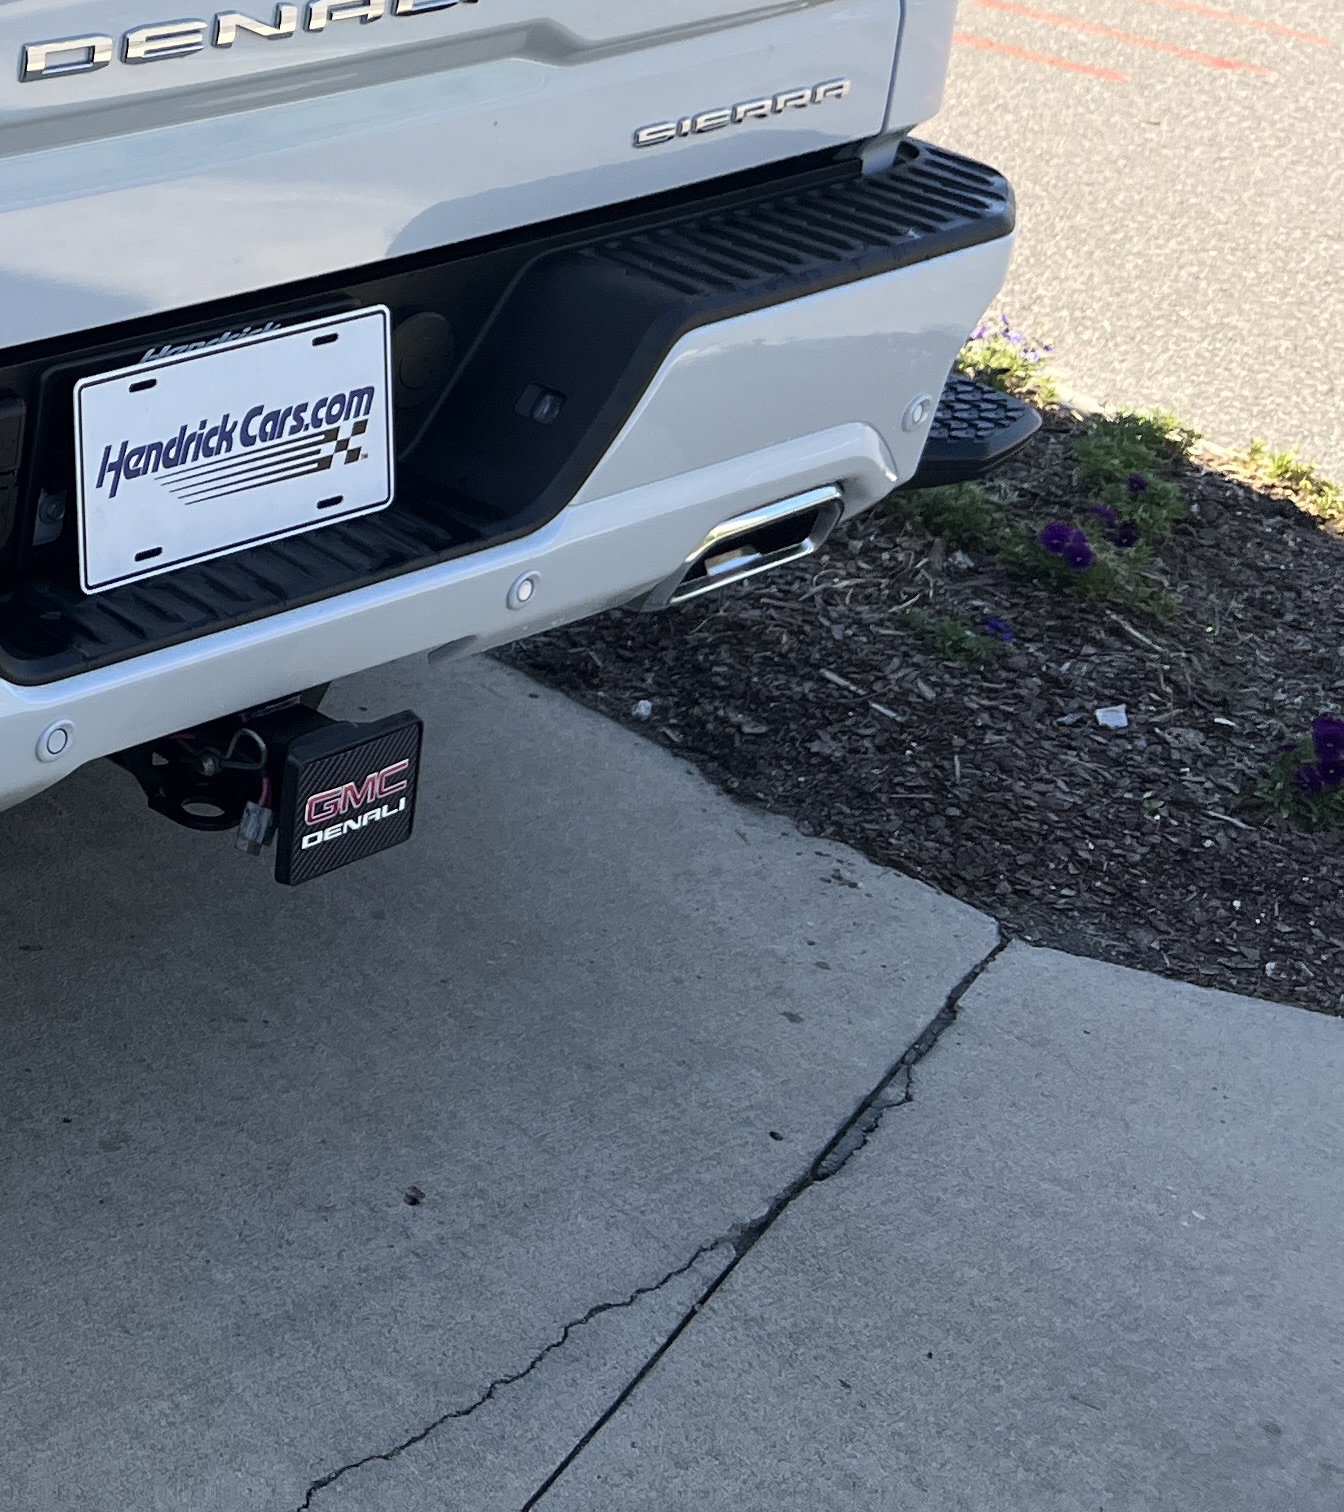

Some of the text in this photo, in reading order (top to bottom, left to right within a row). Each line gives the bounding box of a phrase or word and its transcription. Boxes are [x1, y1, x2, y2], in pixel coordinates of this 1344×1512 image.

[632, 76, 852, 149] SIERRA
[301, 796, 407, 851] DENALI
[304, 758, 410, 827] GMC
